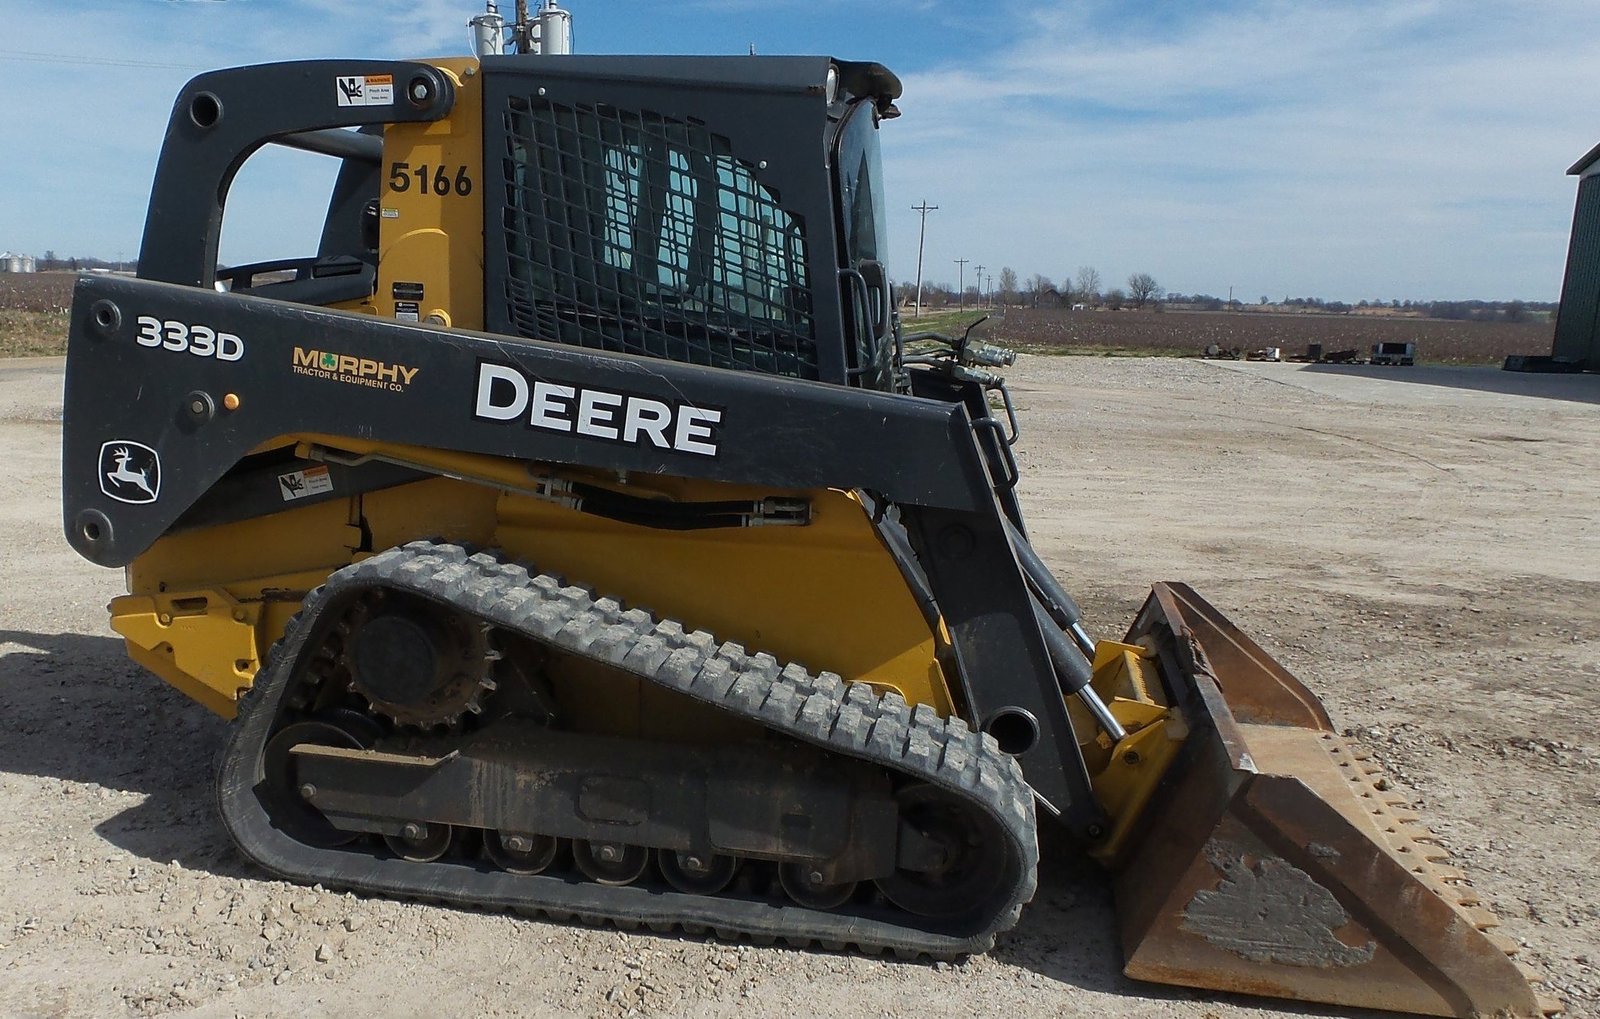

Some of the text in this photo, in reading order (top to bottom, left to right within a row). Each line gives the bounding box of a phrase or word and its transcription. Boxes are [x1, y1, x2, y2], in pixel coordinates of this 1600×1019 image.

[388, 162, 472, 196] 5166
[136, 316, 245, 362] 333D
[292, 346, 420, 385] MURPHY
[292, 365, 331, 379] TRACTOR
[340, 374, 388, 389] EQUIPMENT
[389, 383, 404, 392] CO.
[475, 362, 721, 456] DEERE
